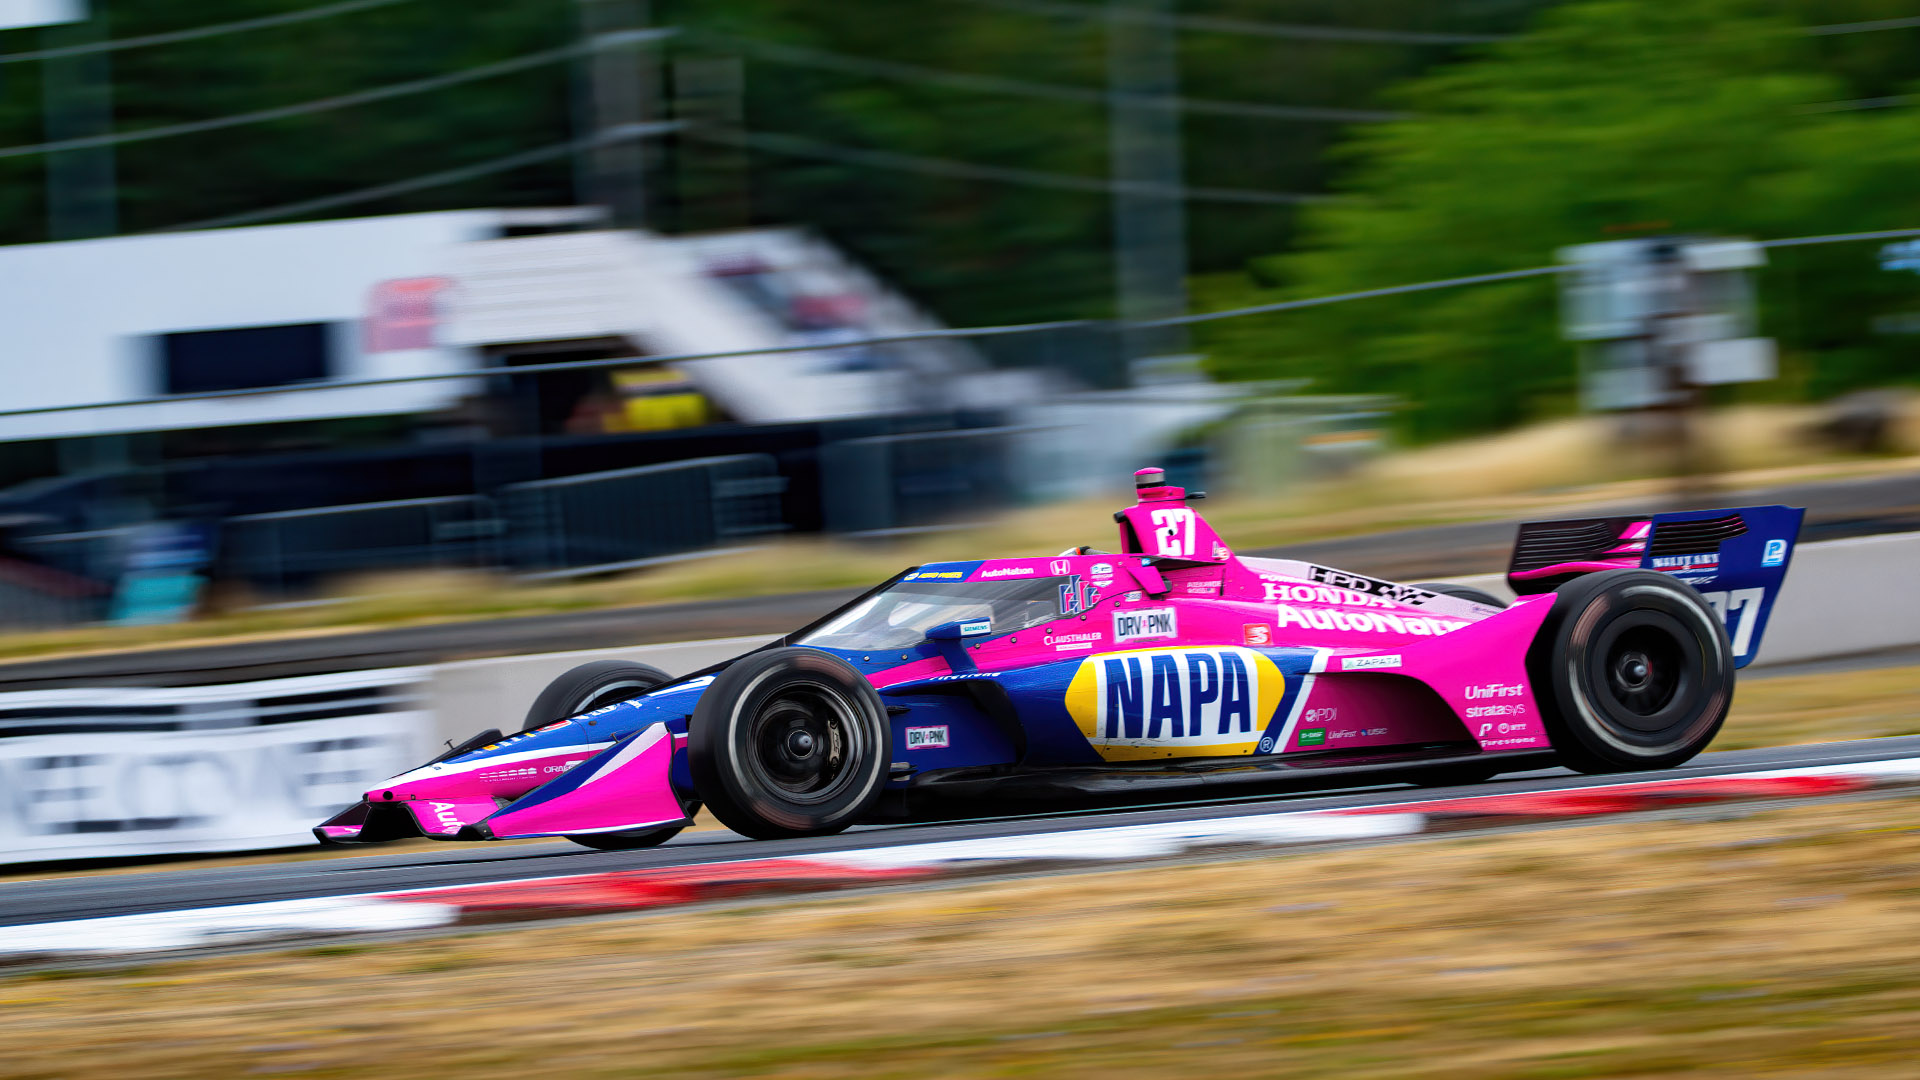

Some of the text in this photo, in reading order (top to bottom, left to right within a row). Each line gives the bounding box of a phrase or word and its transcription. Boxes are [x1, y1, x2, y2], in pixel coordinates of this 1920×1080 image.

[1151, 508, 1195, 556] 27
[1652, 553, 1720, 568] MILITARY
[981, 567, 1034, 578] AutoNation
[1310, 566, 1373, 593] HPD
[1261, 582, 1397, 609] HONDA
[1043, 632, 1102, 646] CLAUSTHALER
[1356, 657, 1400, 667] ZAPATA
[1103, 651, 1251, 739] NAPA
[1464, 683, 1524, 700] UniFirst
[1316, 707, 1338, 722] PDI
[1465, 703, 1526, 718] stratasys
[1480, 737, 1536, 748] Firestone
